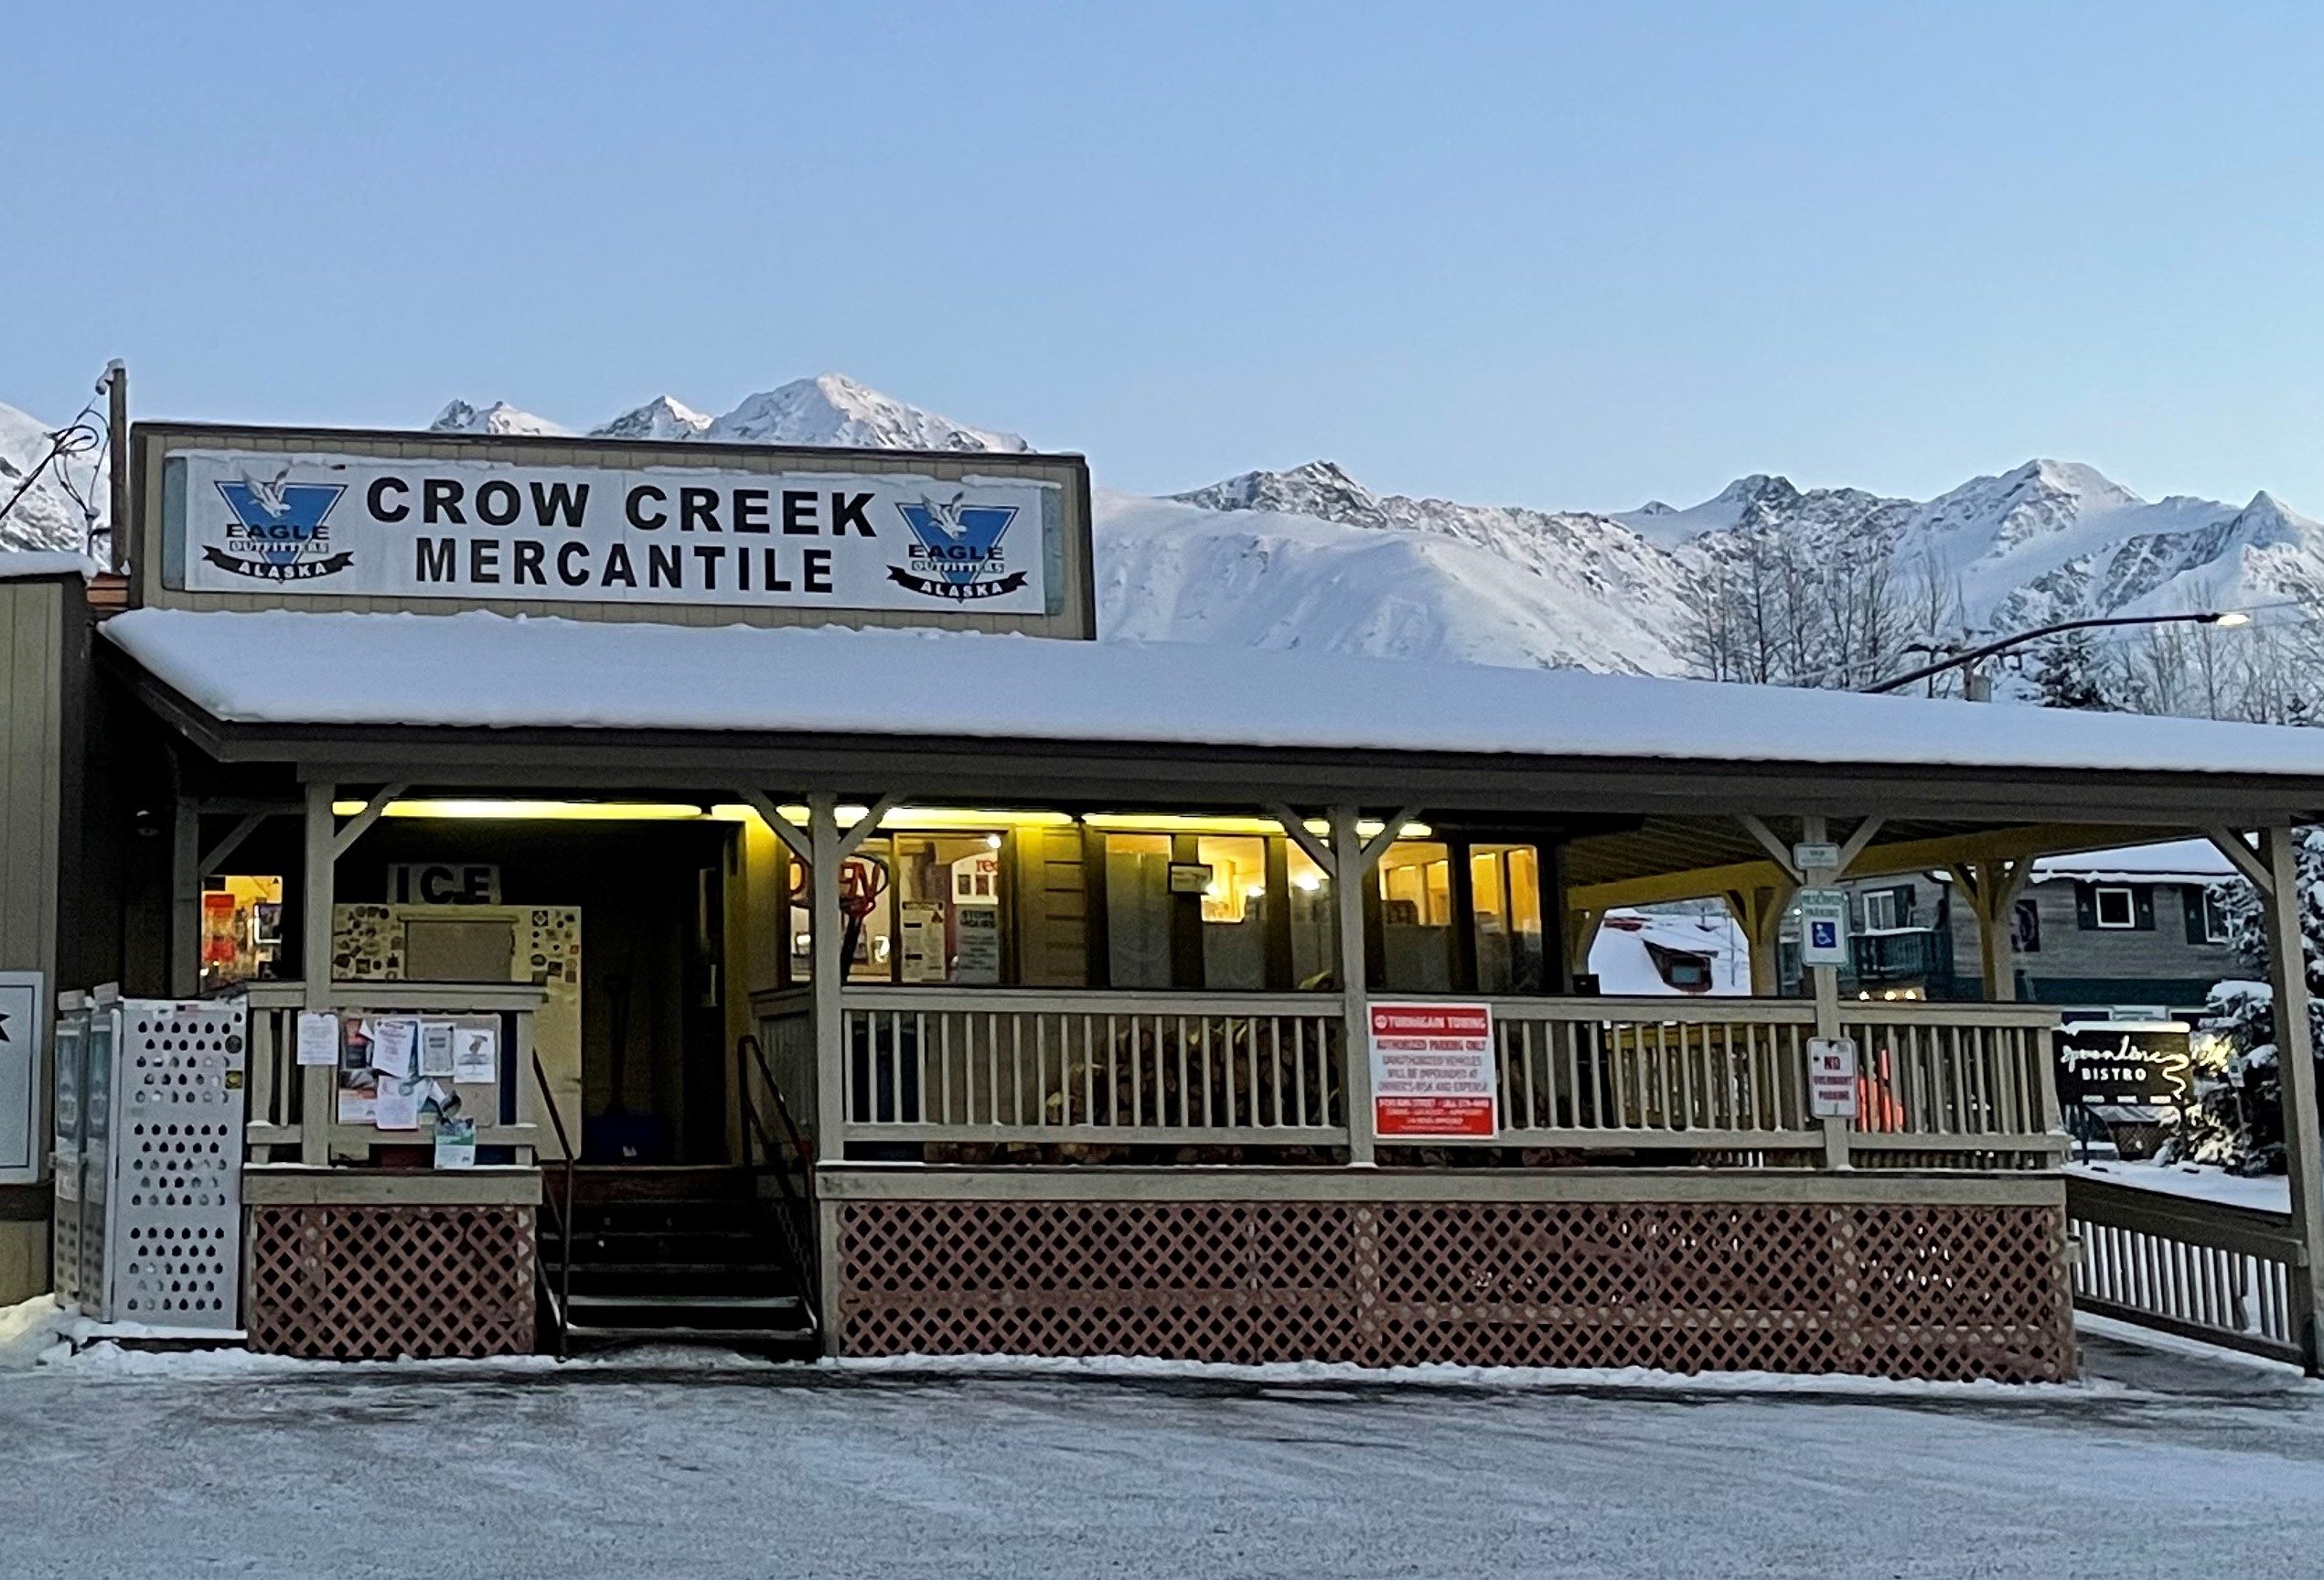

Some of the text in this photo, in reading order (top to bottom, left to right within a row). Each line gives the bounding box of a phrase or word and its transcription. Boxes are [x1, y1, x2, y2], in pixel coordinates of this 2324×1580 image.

[367, 476, 878, 538] CROW CREEK
[226, 522, 330, 541] EAGLE
[230, 540, 329, 554] OUTFITTERS
[908, 543, 1004, 561] EAGLE
[238, 561, 327, 578] ALASKA
[416, 537, 833, 594] MERCANTILE
[912, 560, 1004, 574] OUTFITTERS
[920, 580, 1003, 597] ALASKA
[396, 865, 491, 905] ICE
[1376, 1038, 1487, 1051] AUTHORIZED PARKING ONLY
[1824, 1055, 1841, 1070] NO
[2082, 1068, 2147, 1081] BISTRO
